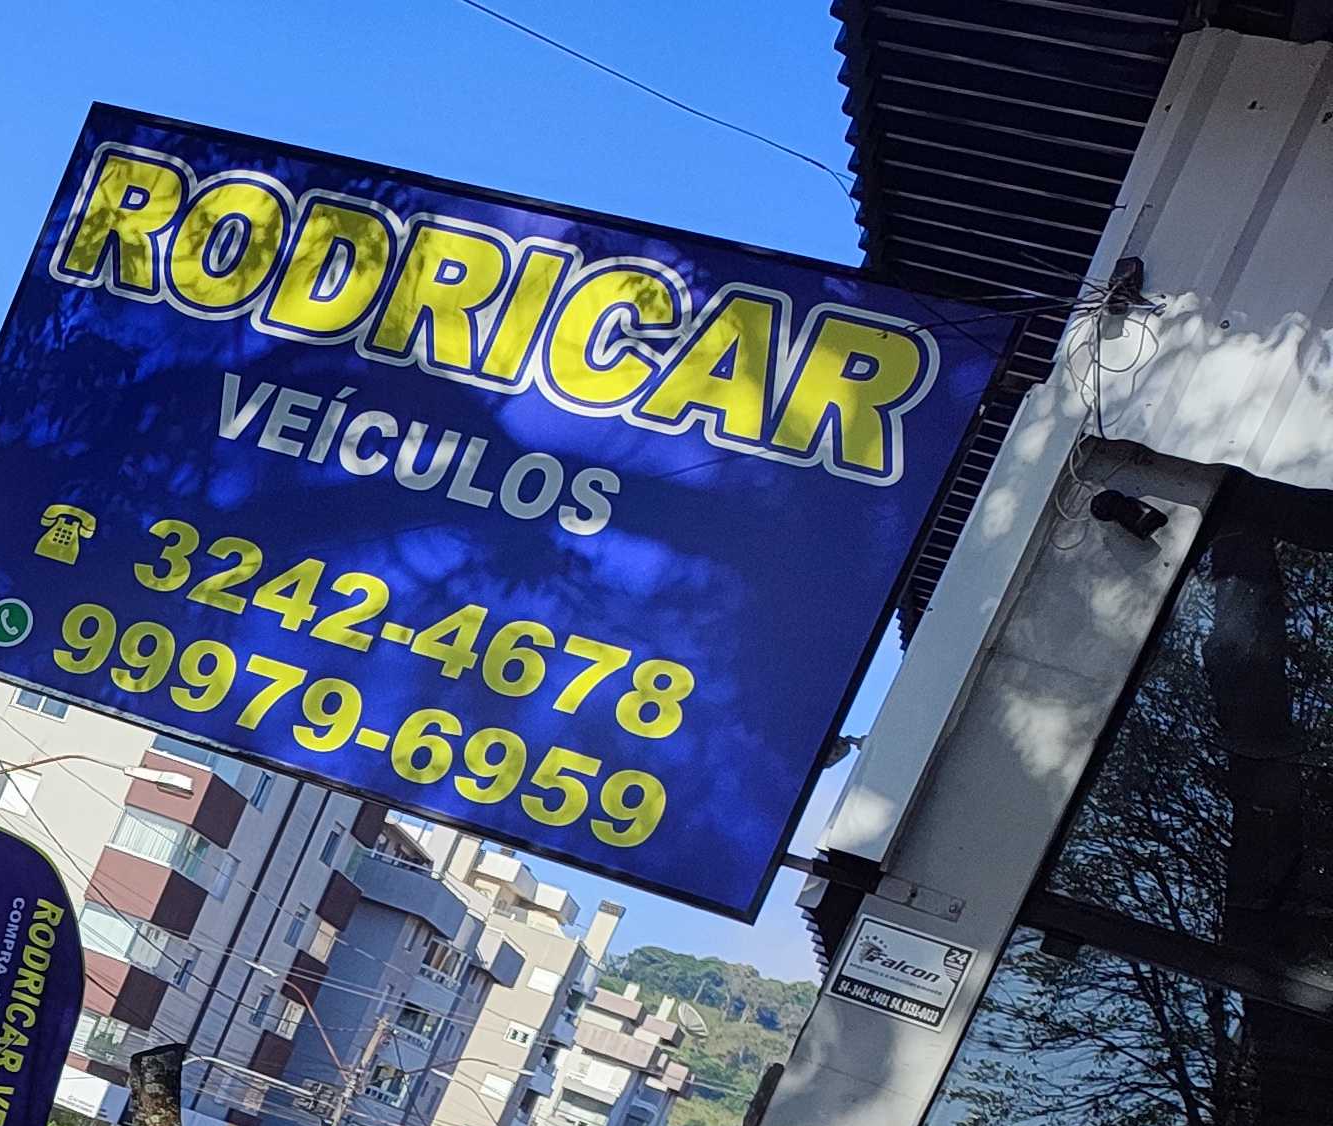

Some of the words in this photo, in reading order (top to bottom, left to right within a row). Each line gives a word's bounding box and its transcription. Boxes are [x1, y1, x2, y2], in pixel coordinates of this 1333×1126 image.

[53, 146, 934, 484] RODRICAR
[216, 373, 620, 537] VEÍCULOS
[52, 602, 667, 848] 99979-6959
[133, 518, 696, 739] 3242-4678
[946, 951, 968, 964] 24
